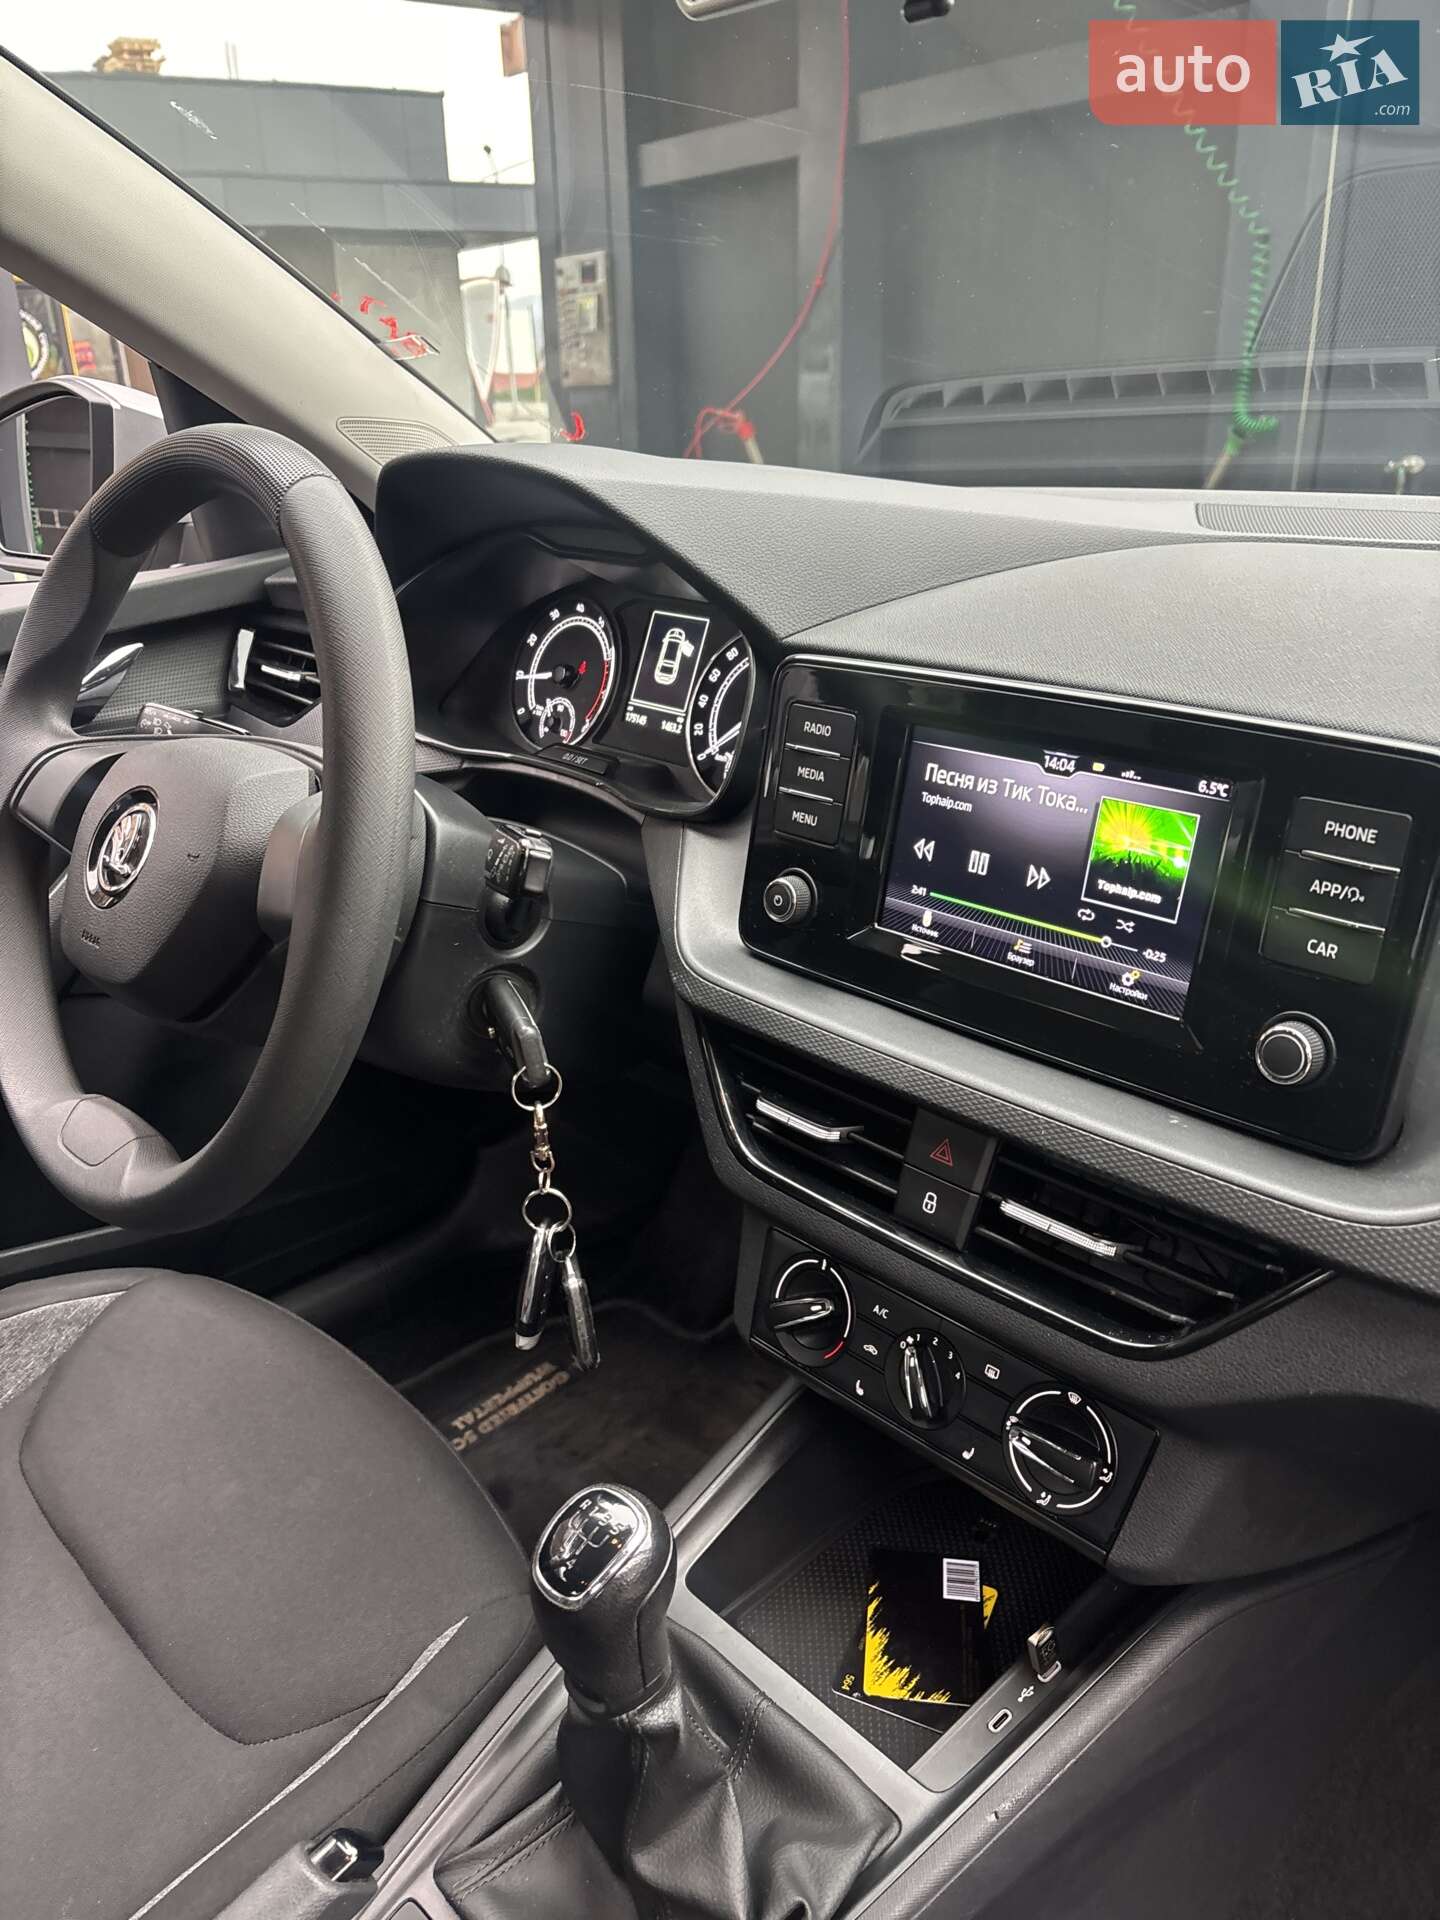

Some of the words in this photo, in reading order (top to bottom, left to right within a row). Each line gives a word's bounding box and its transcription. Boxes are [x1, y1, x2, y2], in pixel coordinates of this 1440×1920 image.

[526, 632, 538, 647] 20
[549, 608, 561, 621] 30
[575, 603, 585, 613] 40
[725, 647, 739, 661] 80
[708, 668, 721, 683] 60
[697, 694, 709, 709] 40
[693, 722, 704, 736] 20
[803, 720, 832, 737] RADIO
[1044, 755, 1076, 773] 14:04
[797, 766, 825, 783] MEDIA
[924, 763, 974, 791] Песня
[977, 775, 998, 795] из
[1002, 778, 1033, 803] Тик
[921, 791, 973, 813] Tophaip.com
[791, 810, 818, 827] MENU
[1324, 820, 1379, 844] PHONE
[1306, 939, 1338, 960] CAR
[1007, 951, 1035, 968] Браузер
[1109, 982, 1149, 1001] Настройки
[872, 1304, 889, 1319] A/C
[900, 1341, 907, 1349] 0
[916, 1333, 920, 1341] 1
[932, 1337, 939, 1346] 2
[948, 1351, 953, 1360] 3
[955, 1371, 961, 1380] 4
[579, 1499, 592, 1510] R
[588, 1506, 599, 1517] 1
[598, 1513, 613, 1526] 3
[609, 1522, 625, 1535] 5
[841, 1674, 855, 1691] 564
